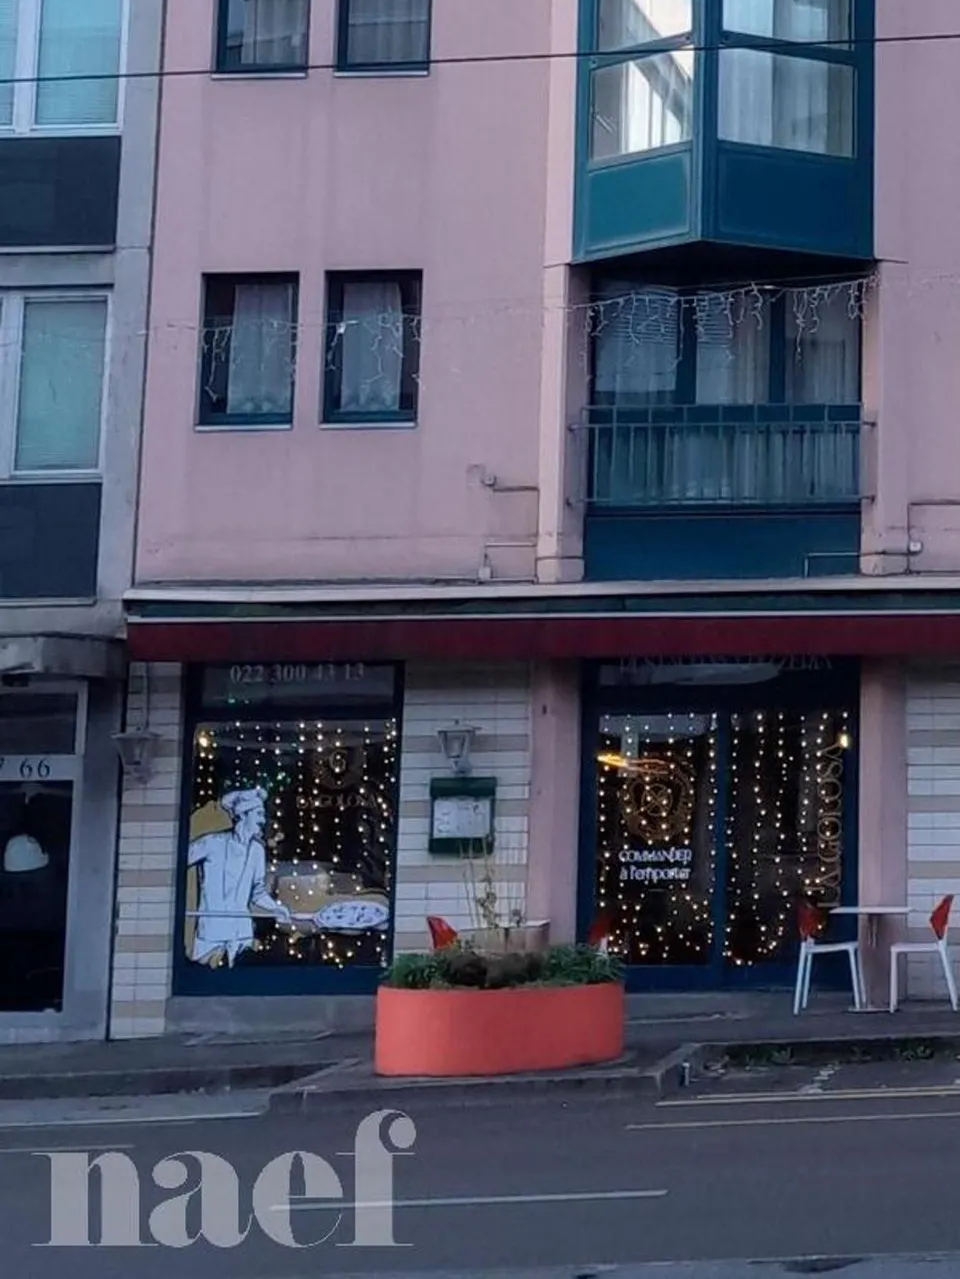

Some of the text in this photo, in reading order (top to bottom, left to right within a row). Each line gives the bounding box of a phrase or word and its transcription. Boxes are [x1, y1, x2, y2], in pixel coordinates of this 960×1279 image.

[229, 663, 265, 684] 022
[270, 663, 307, 682] 300
[19, 758, 51, 778] 66
[618, 849, 693, 862] COMMANDER
